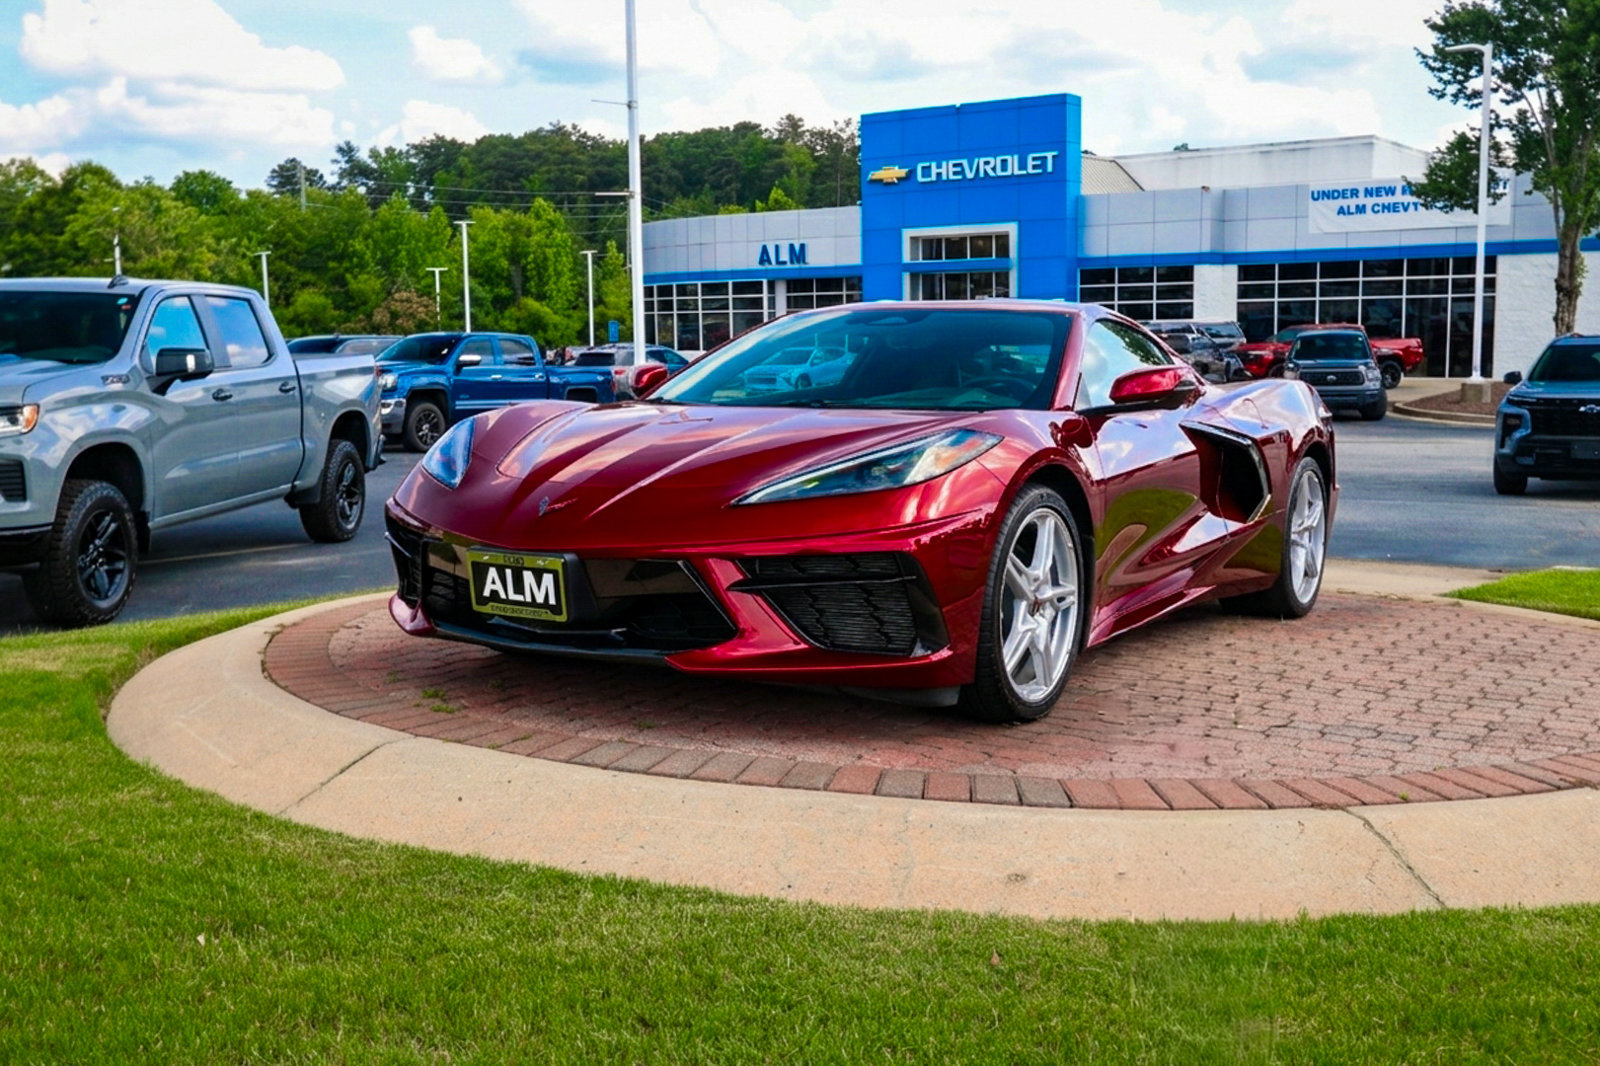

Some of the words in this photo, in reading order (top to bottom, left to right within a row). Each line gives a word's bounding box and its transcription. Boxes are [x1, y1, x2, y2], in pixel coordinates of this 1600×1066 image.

[917, 151, 1059, 183] CHEVROLET
[1310, 187, 1360, 202] UNDER
[1364, 185, 1397, 199] NEW
[1336, 203, 1367, 217] ALM
[758, 242, 807, 266] ALM
[482, 566, 557, 606] ALM
